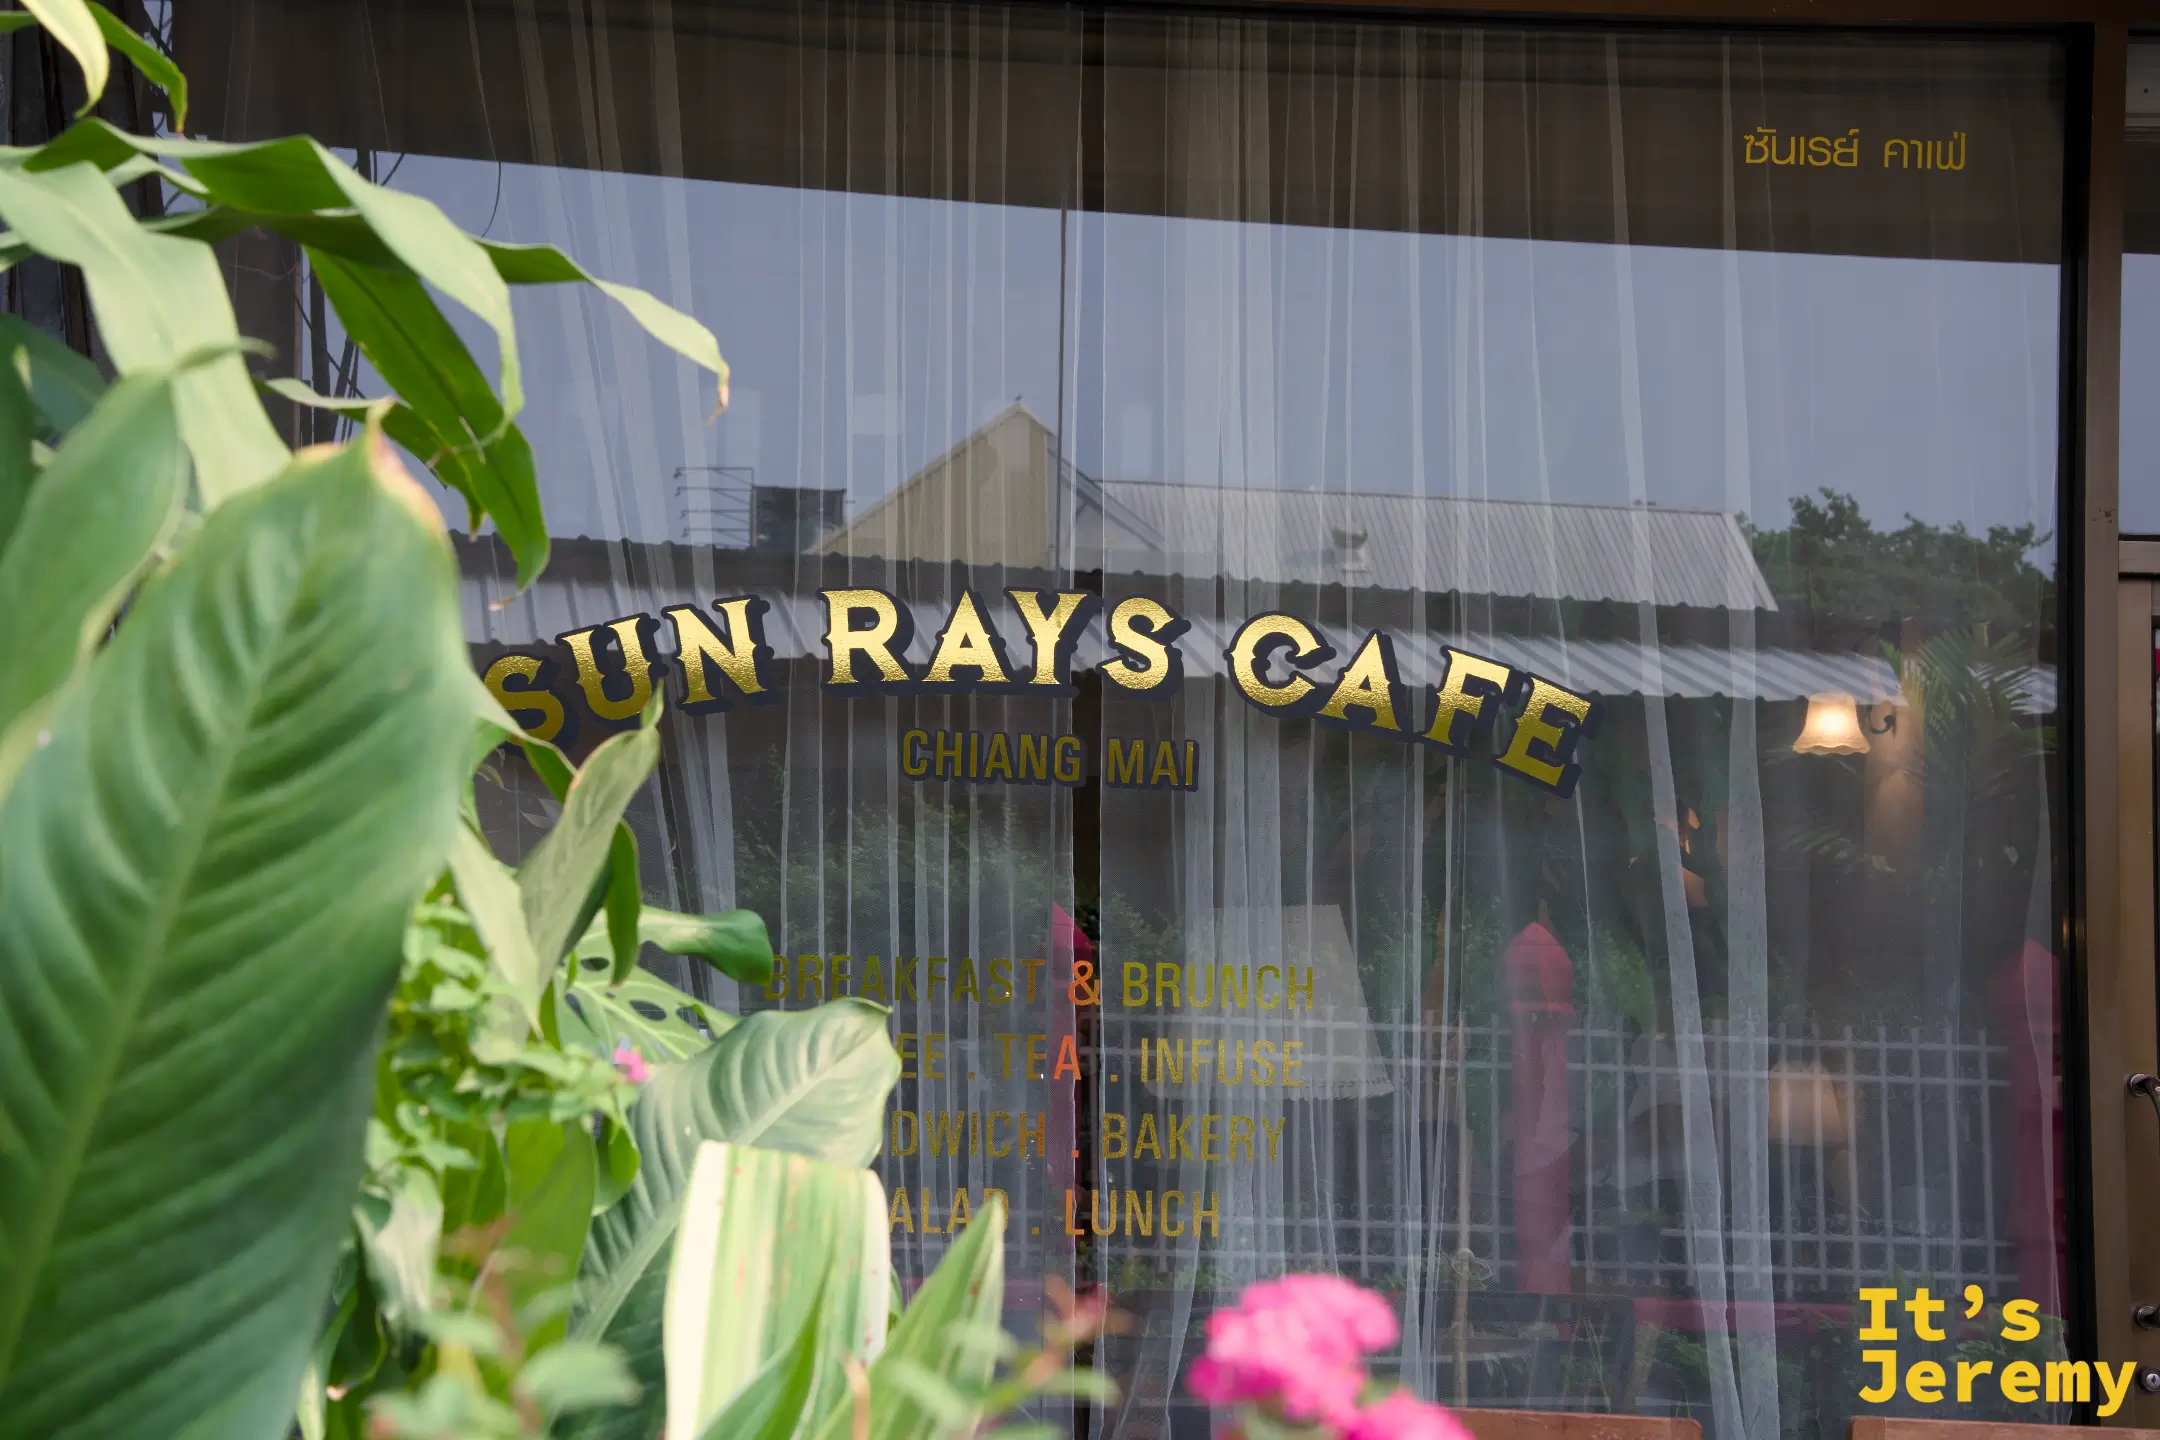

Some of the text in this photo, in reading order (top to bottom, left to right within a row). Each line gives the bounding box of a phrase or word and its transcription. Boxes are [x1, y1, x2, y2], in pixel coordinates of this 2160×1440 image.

[1743, 126, 1967, 171] ซันเรย์ คาเฟ่
[482, 588, 1595, 790] SUN RAYS CAFE
[903, 729, 1195, 786] CHIANG MAI
[764, 955, 1314, 1011] BREAKFAST & BRUNCH
[994, 1033, 1082, 1081] TEA
[1139, 1036, 1304, 1087] INFUSE
[877, 1110, 1046, 1158] DWICH
[1101, 1112, 1287, 1162] BAKERY
[889, 1186, 1009, 1235] ALAD
[1064, 1188, 1220, 1238] LUNCH
